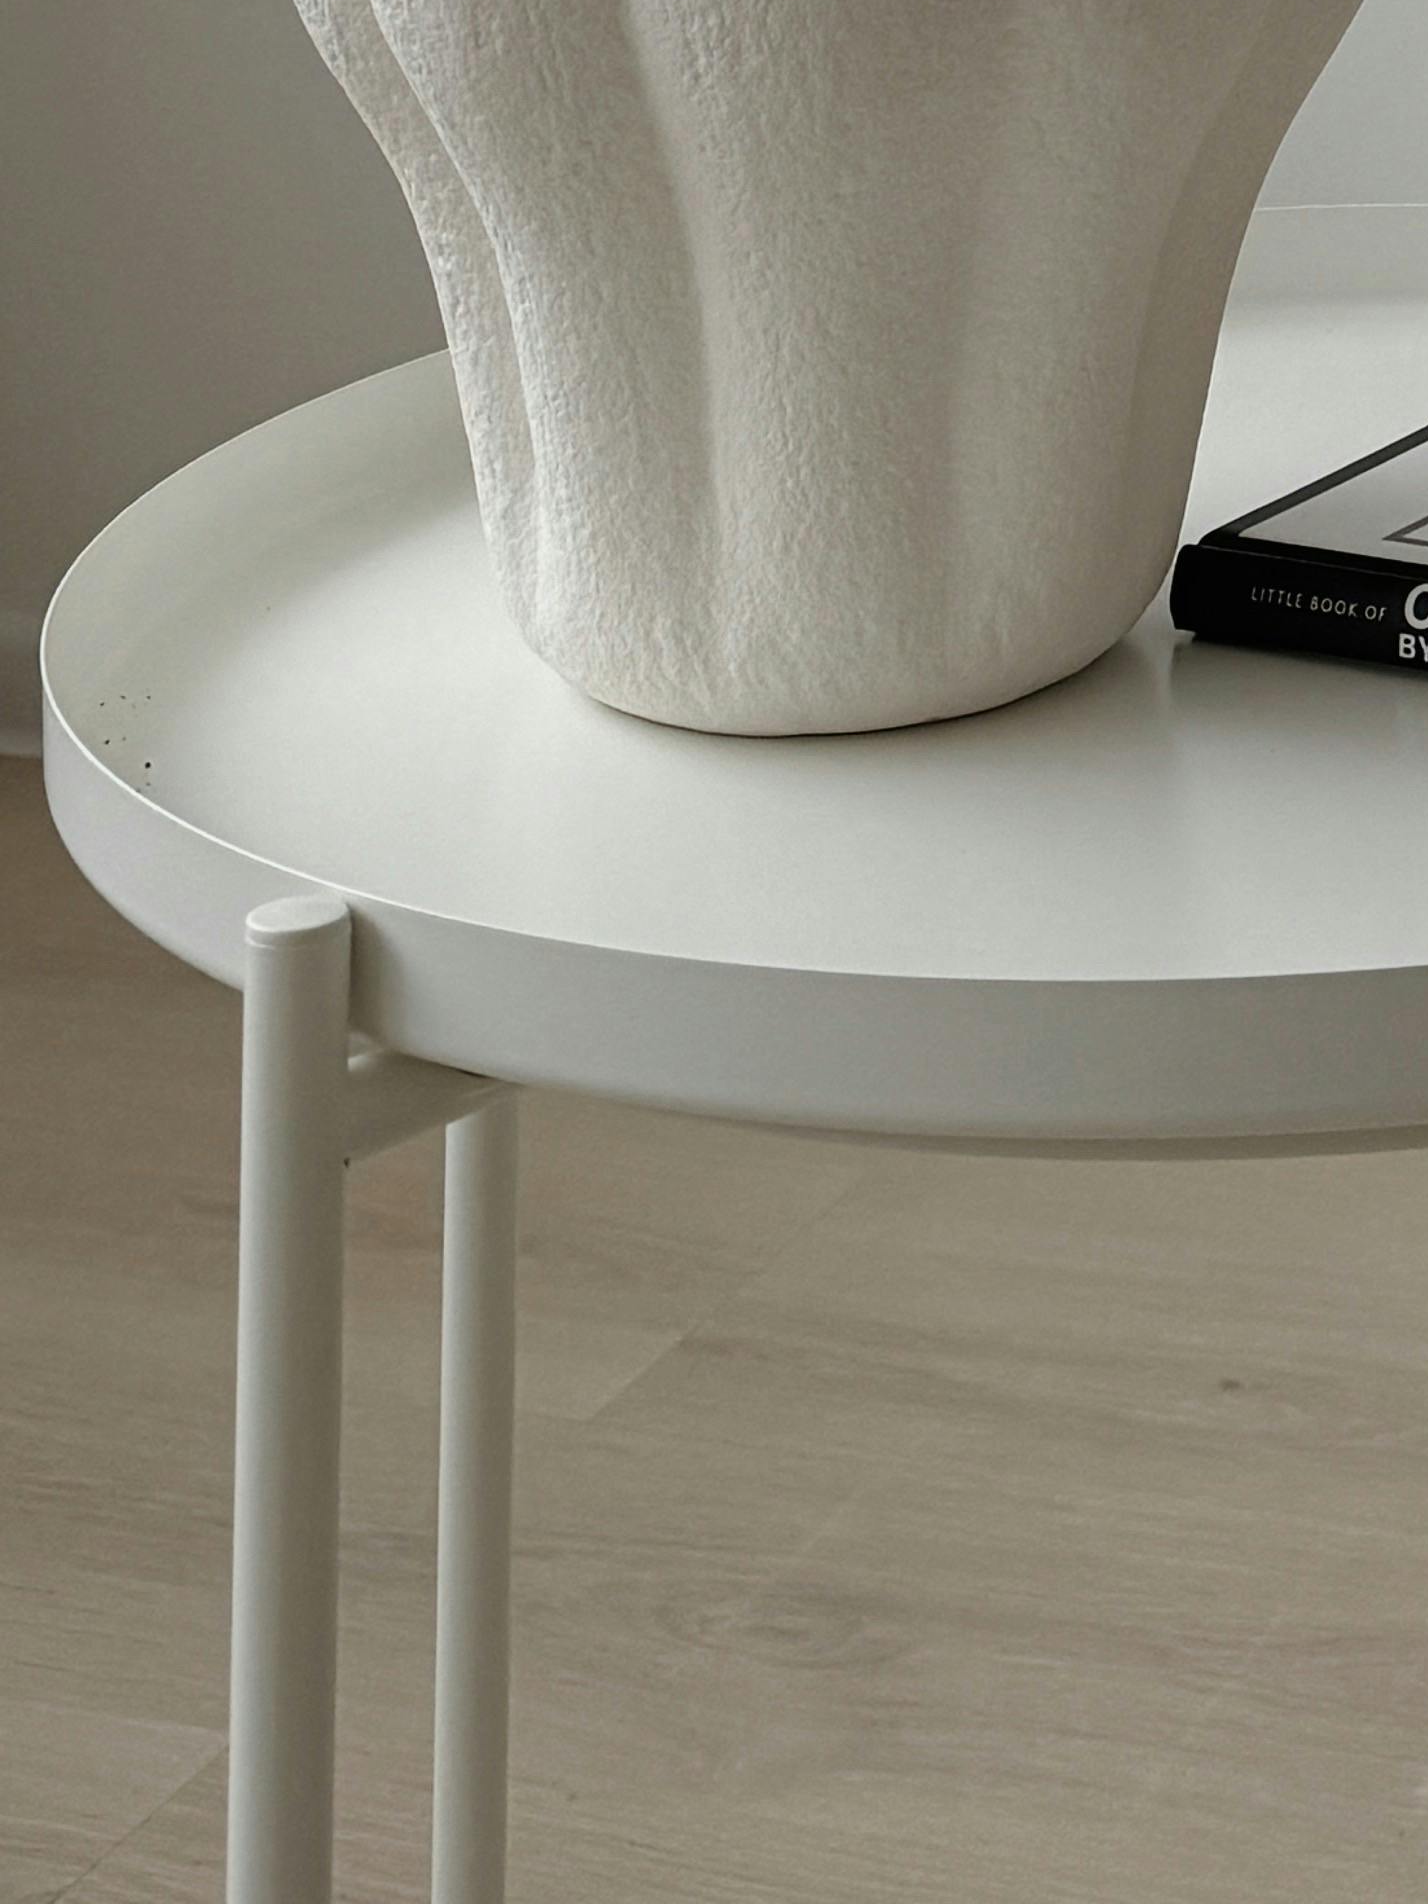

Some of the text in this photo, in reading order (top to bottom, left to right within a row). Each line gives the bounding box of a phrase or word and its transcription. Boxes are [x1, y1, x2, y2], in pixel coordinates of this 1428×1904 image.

[1250, 586, 1389, 622] LITTLE BOOK OF
